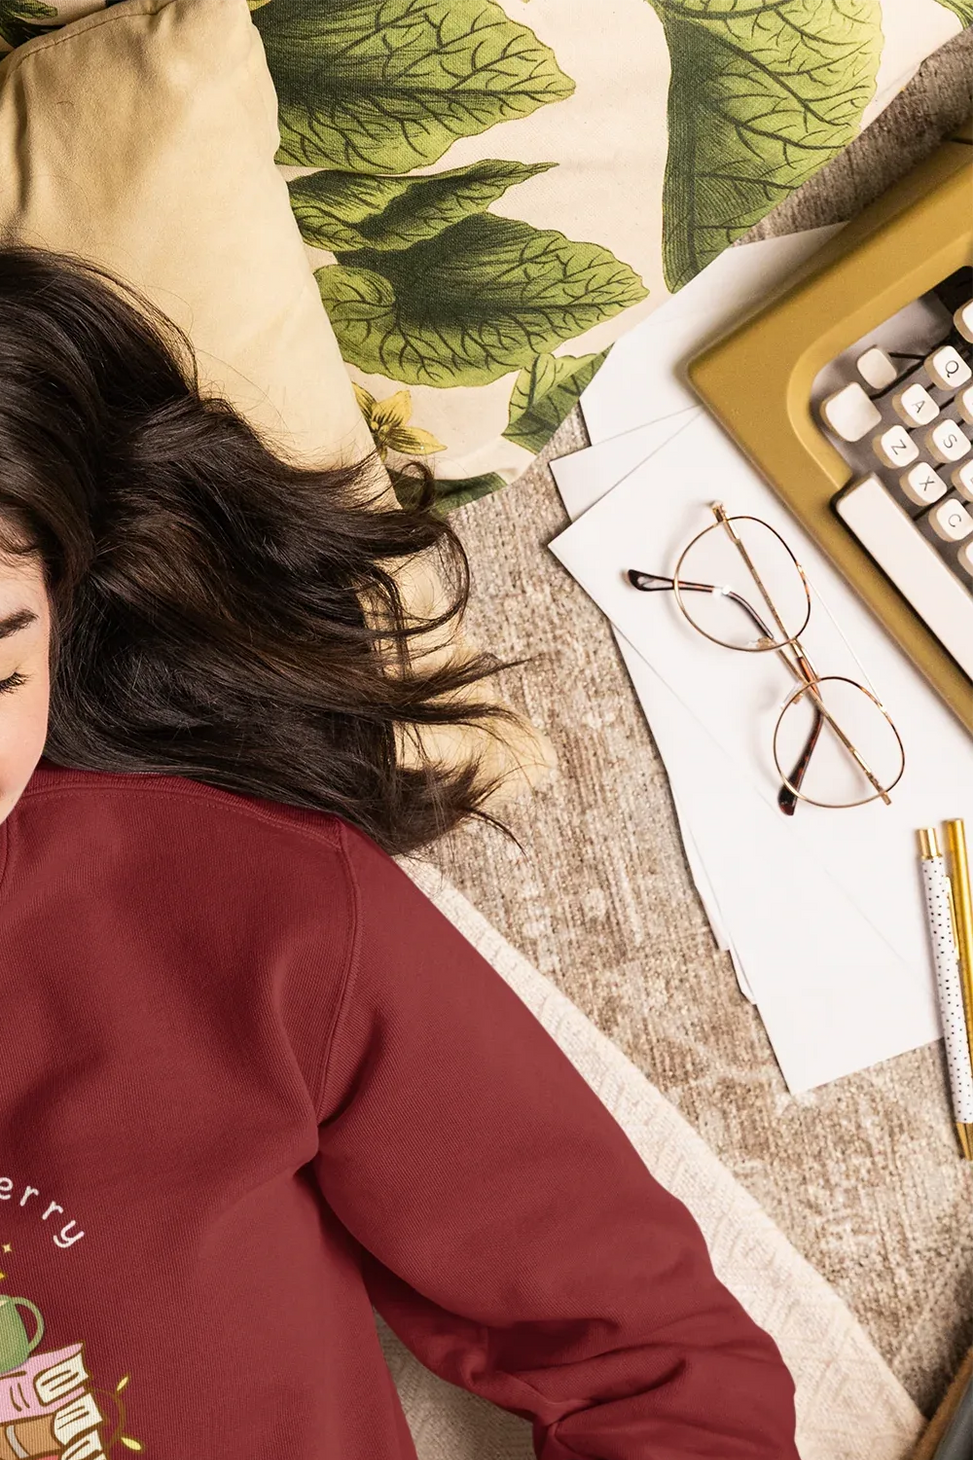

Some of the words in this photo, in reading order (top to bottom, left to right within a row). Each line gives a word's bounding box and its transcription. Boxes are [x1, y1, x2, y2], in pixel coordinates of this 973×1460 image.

[944, 359, 960, 379] Q
[911, 399, 926, 414] A
[890, 438, 907, 456] Z
[942, 433, 958, 449] S
[918, 475, 936, 492] X
[947, 512, 962, 528] C
